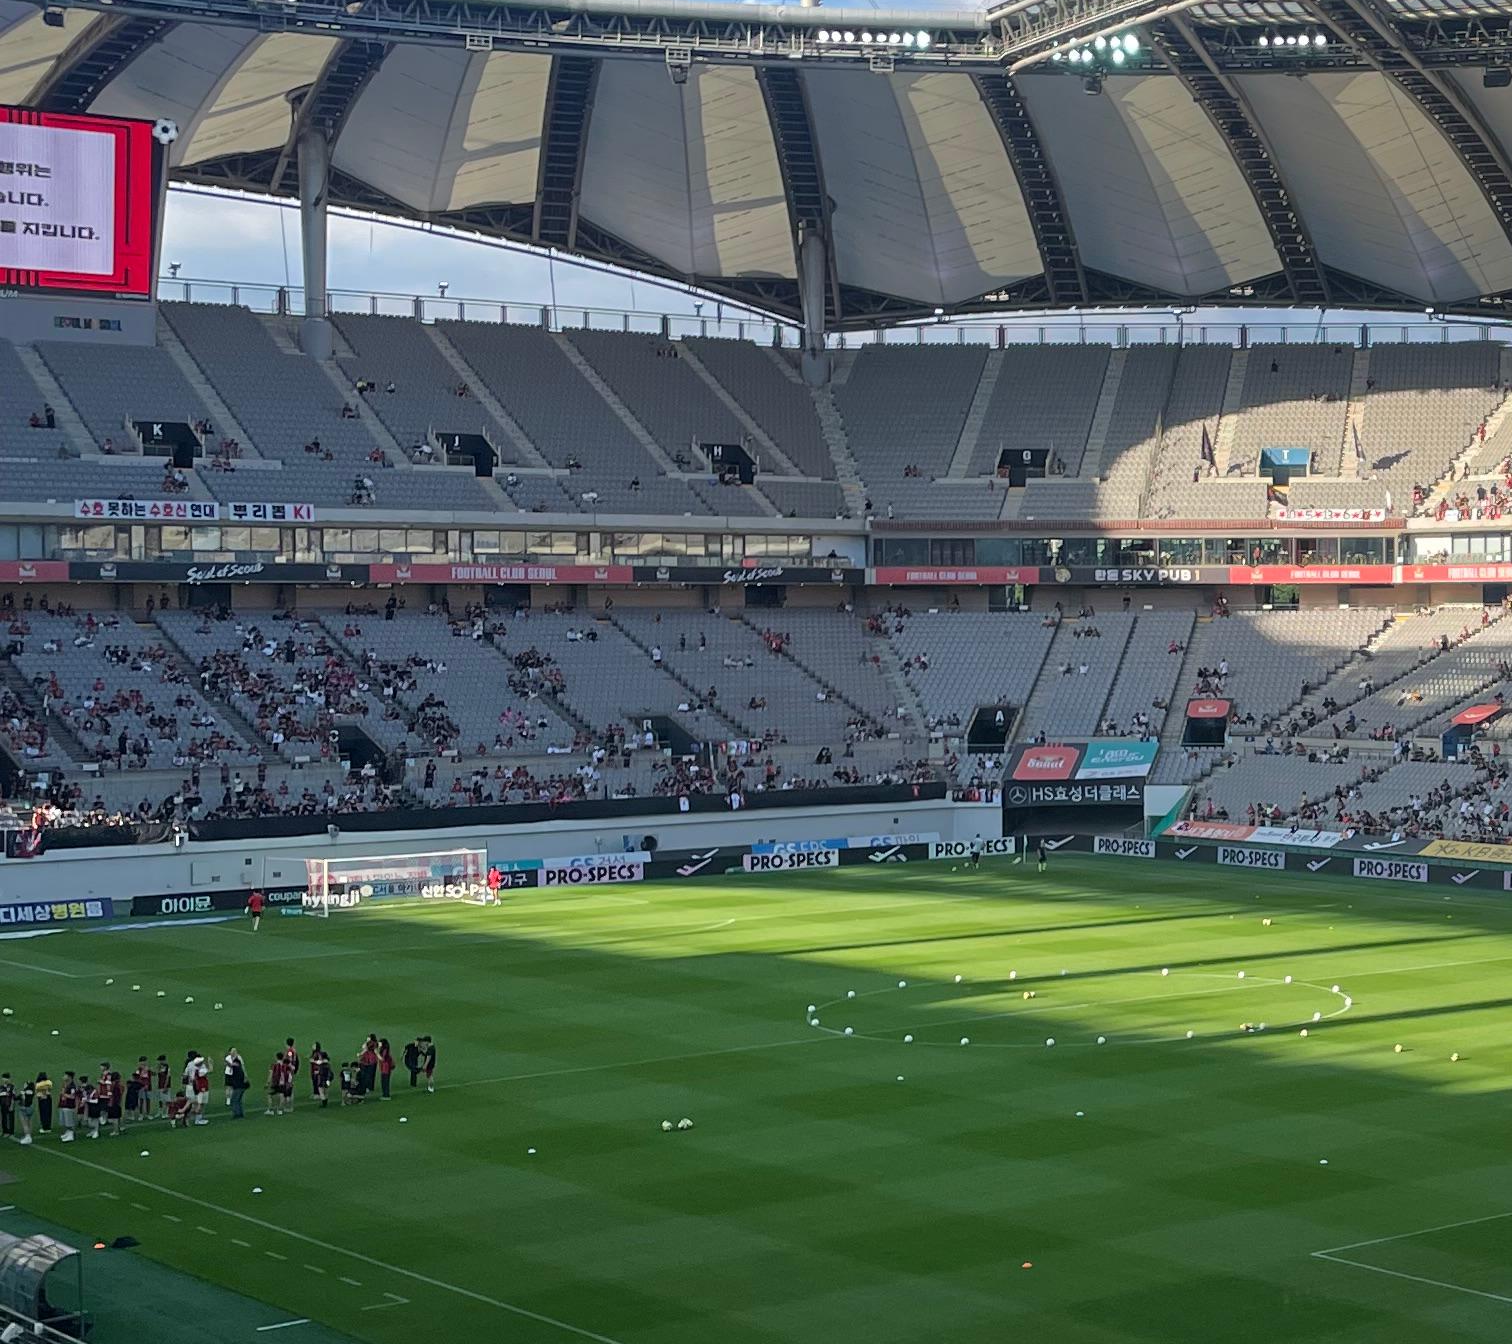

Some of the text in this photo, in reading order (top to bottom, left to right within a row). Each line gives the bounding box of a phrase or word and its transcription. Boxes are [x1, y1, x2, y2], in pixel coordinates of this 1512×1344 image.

[22, 221, 100, 241] 지킵니다.
[153, 424, 163, 435] K
[454, 435, 459, 446] J
[713, 446, 722, 456] H
[1282, 449, 1290, 459] T
[80, 501, 216, 519] 수호 못하는 수호신 연대
[452, 568, 557, 580] FOOTBALL CLUB SEOUL
[1121, 569, 1154, 581] SKY
[1158, 569, 1191, 581] PUB
[1195, 569, 1200, 581] 1
[935, 839, 1008, 856] PRO-ECS
